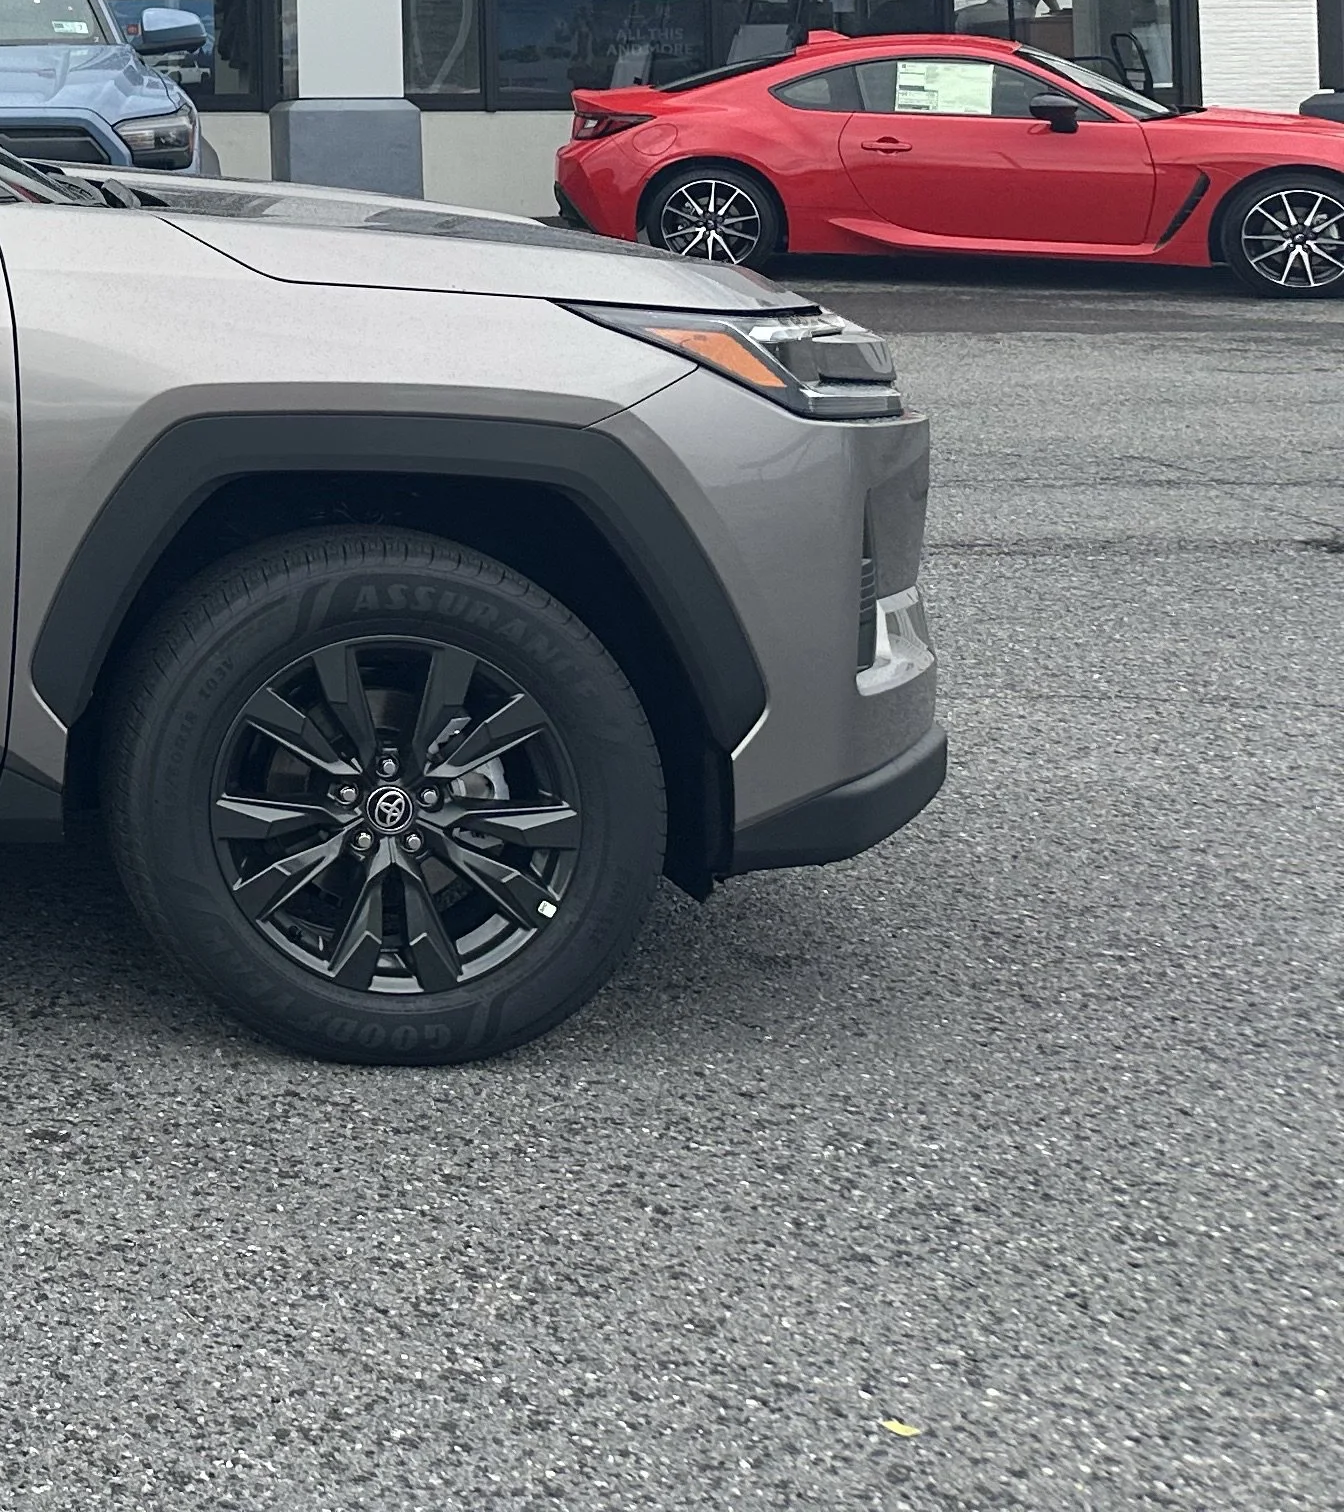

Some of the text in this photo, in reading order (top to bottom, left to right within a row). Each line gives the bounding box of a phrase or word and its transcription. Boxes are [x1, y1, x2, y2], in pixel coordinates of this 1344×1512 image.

[616, 28, 684, 43] ALL THIS
[351, 584, 596, 700] ASSURANCE
